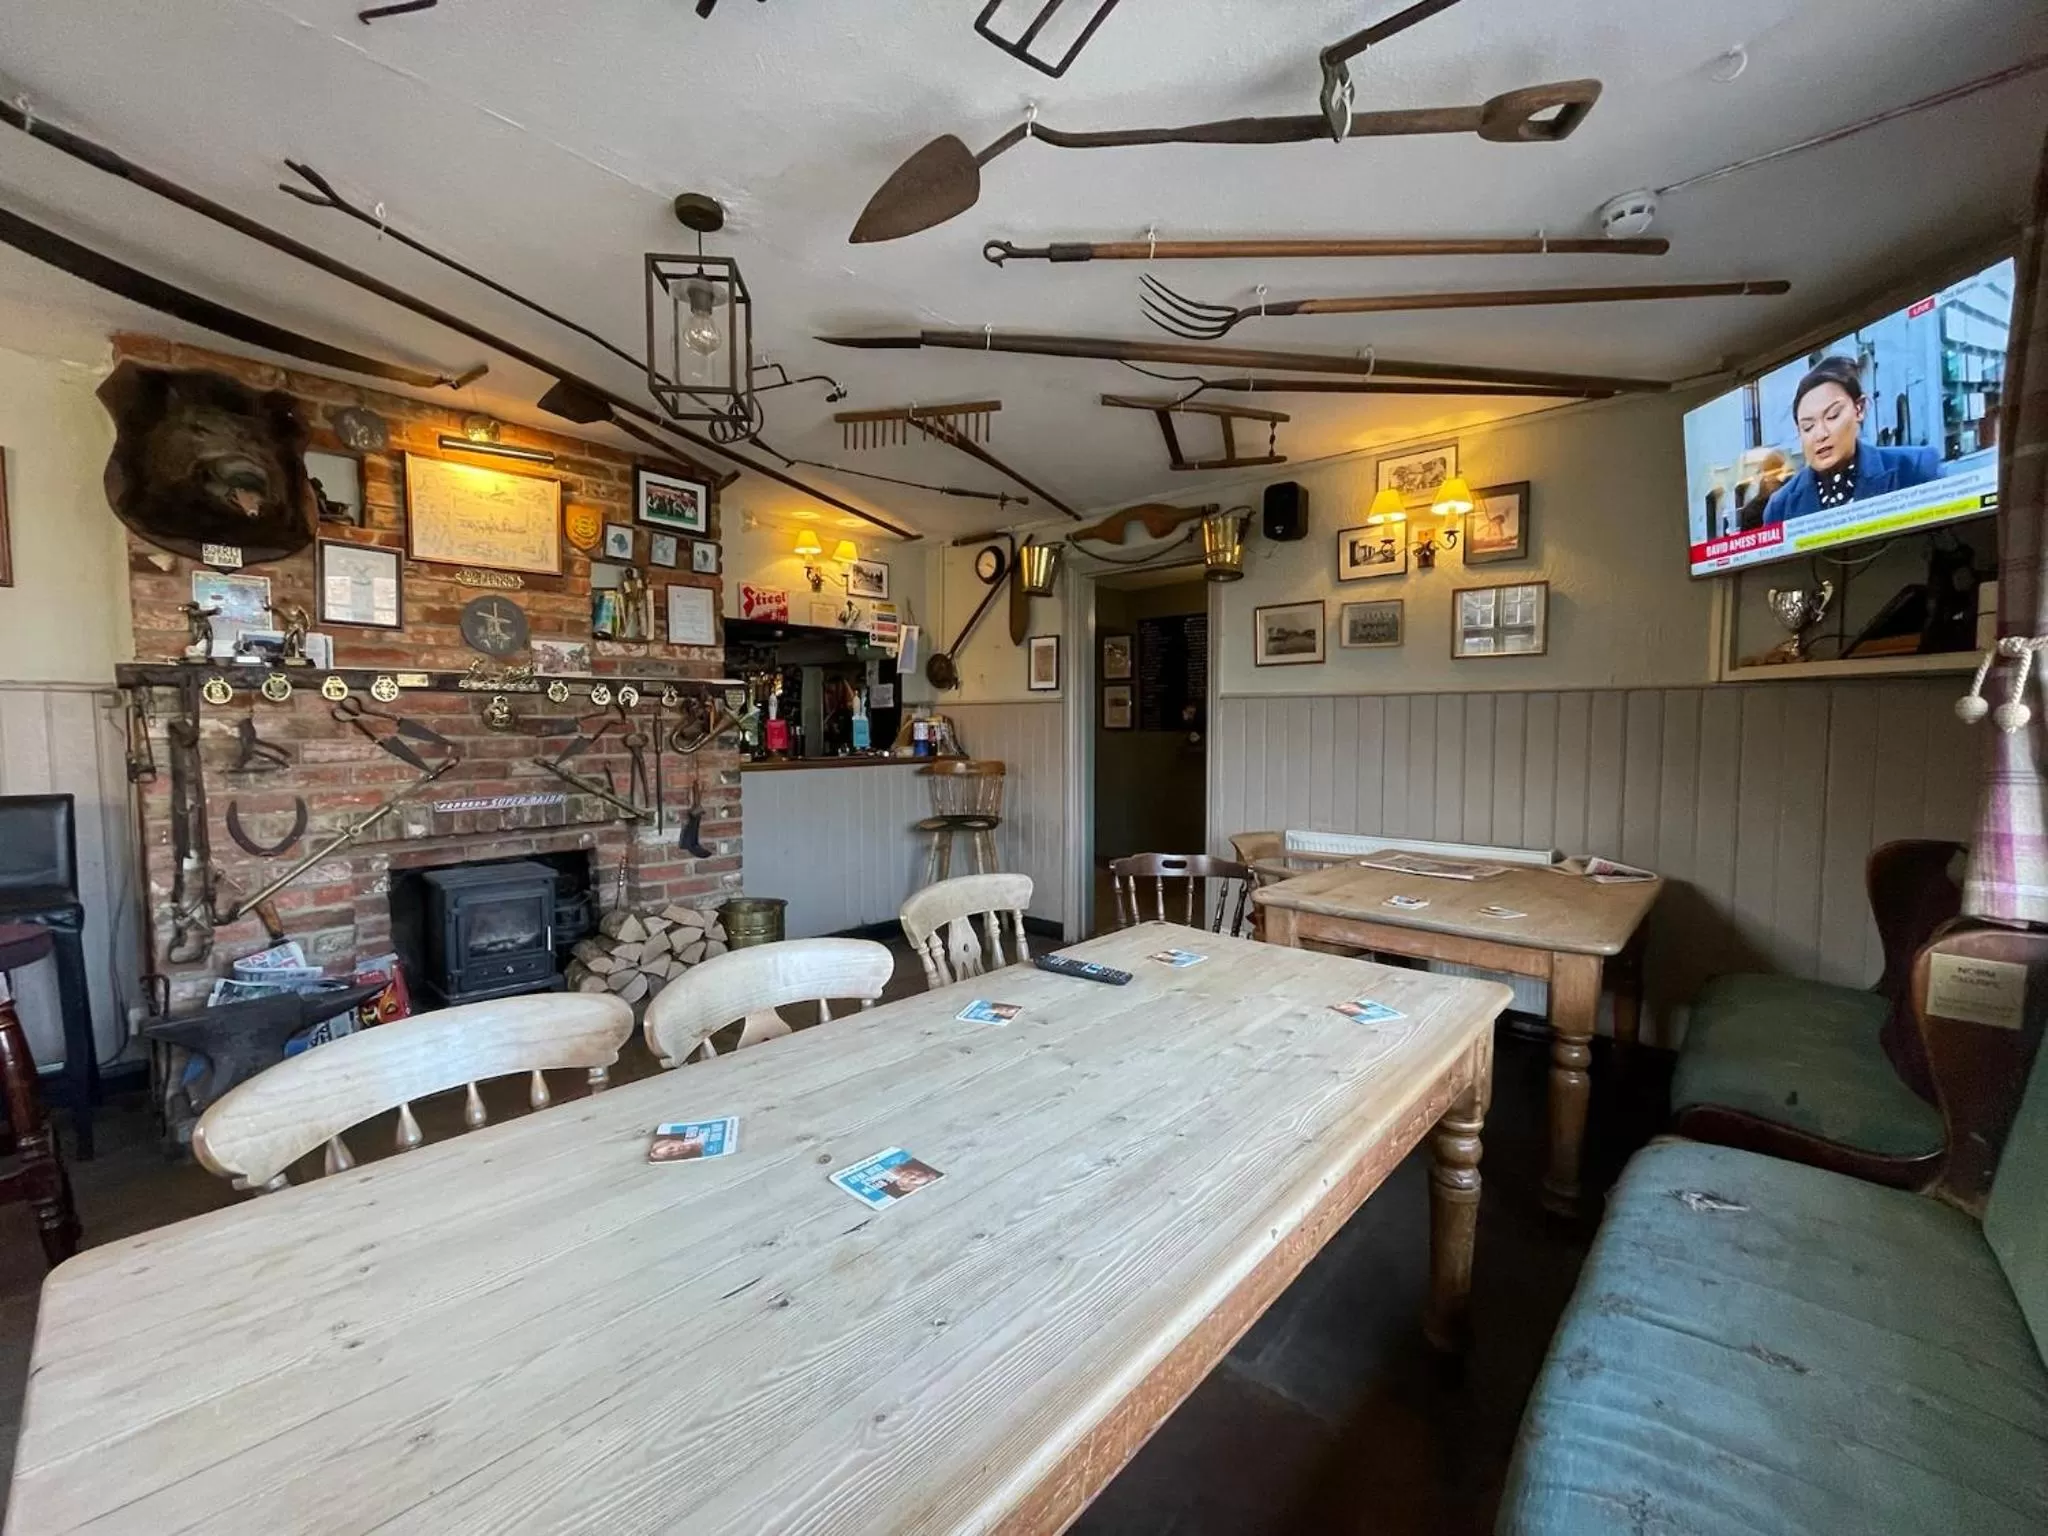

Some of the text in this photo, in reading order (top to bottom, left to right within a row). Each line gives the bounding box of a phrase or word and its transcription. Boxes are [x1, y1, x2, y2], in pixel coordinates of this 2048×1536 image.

[1706, 528, 1781, 557] DAVID AMESS TRIAL
